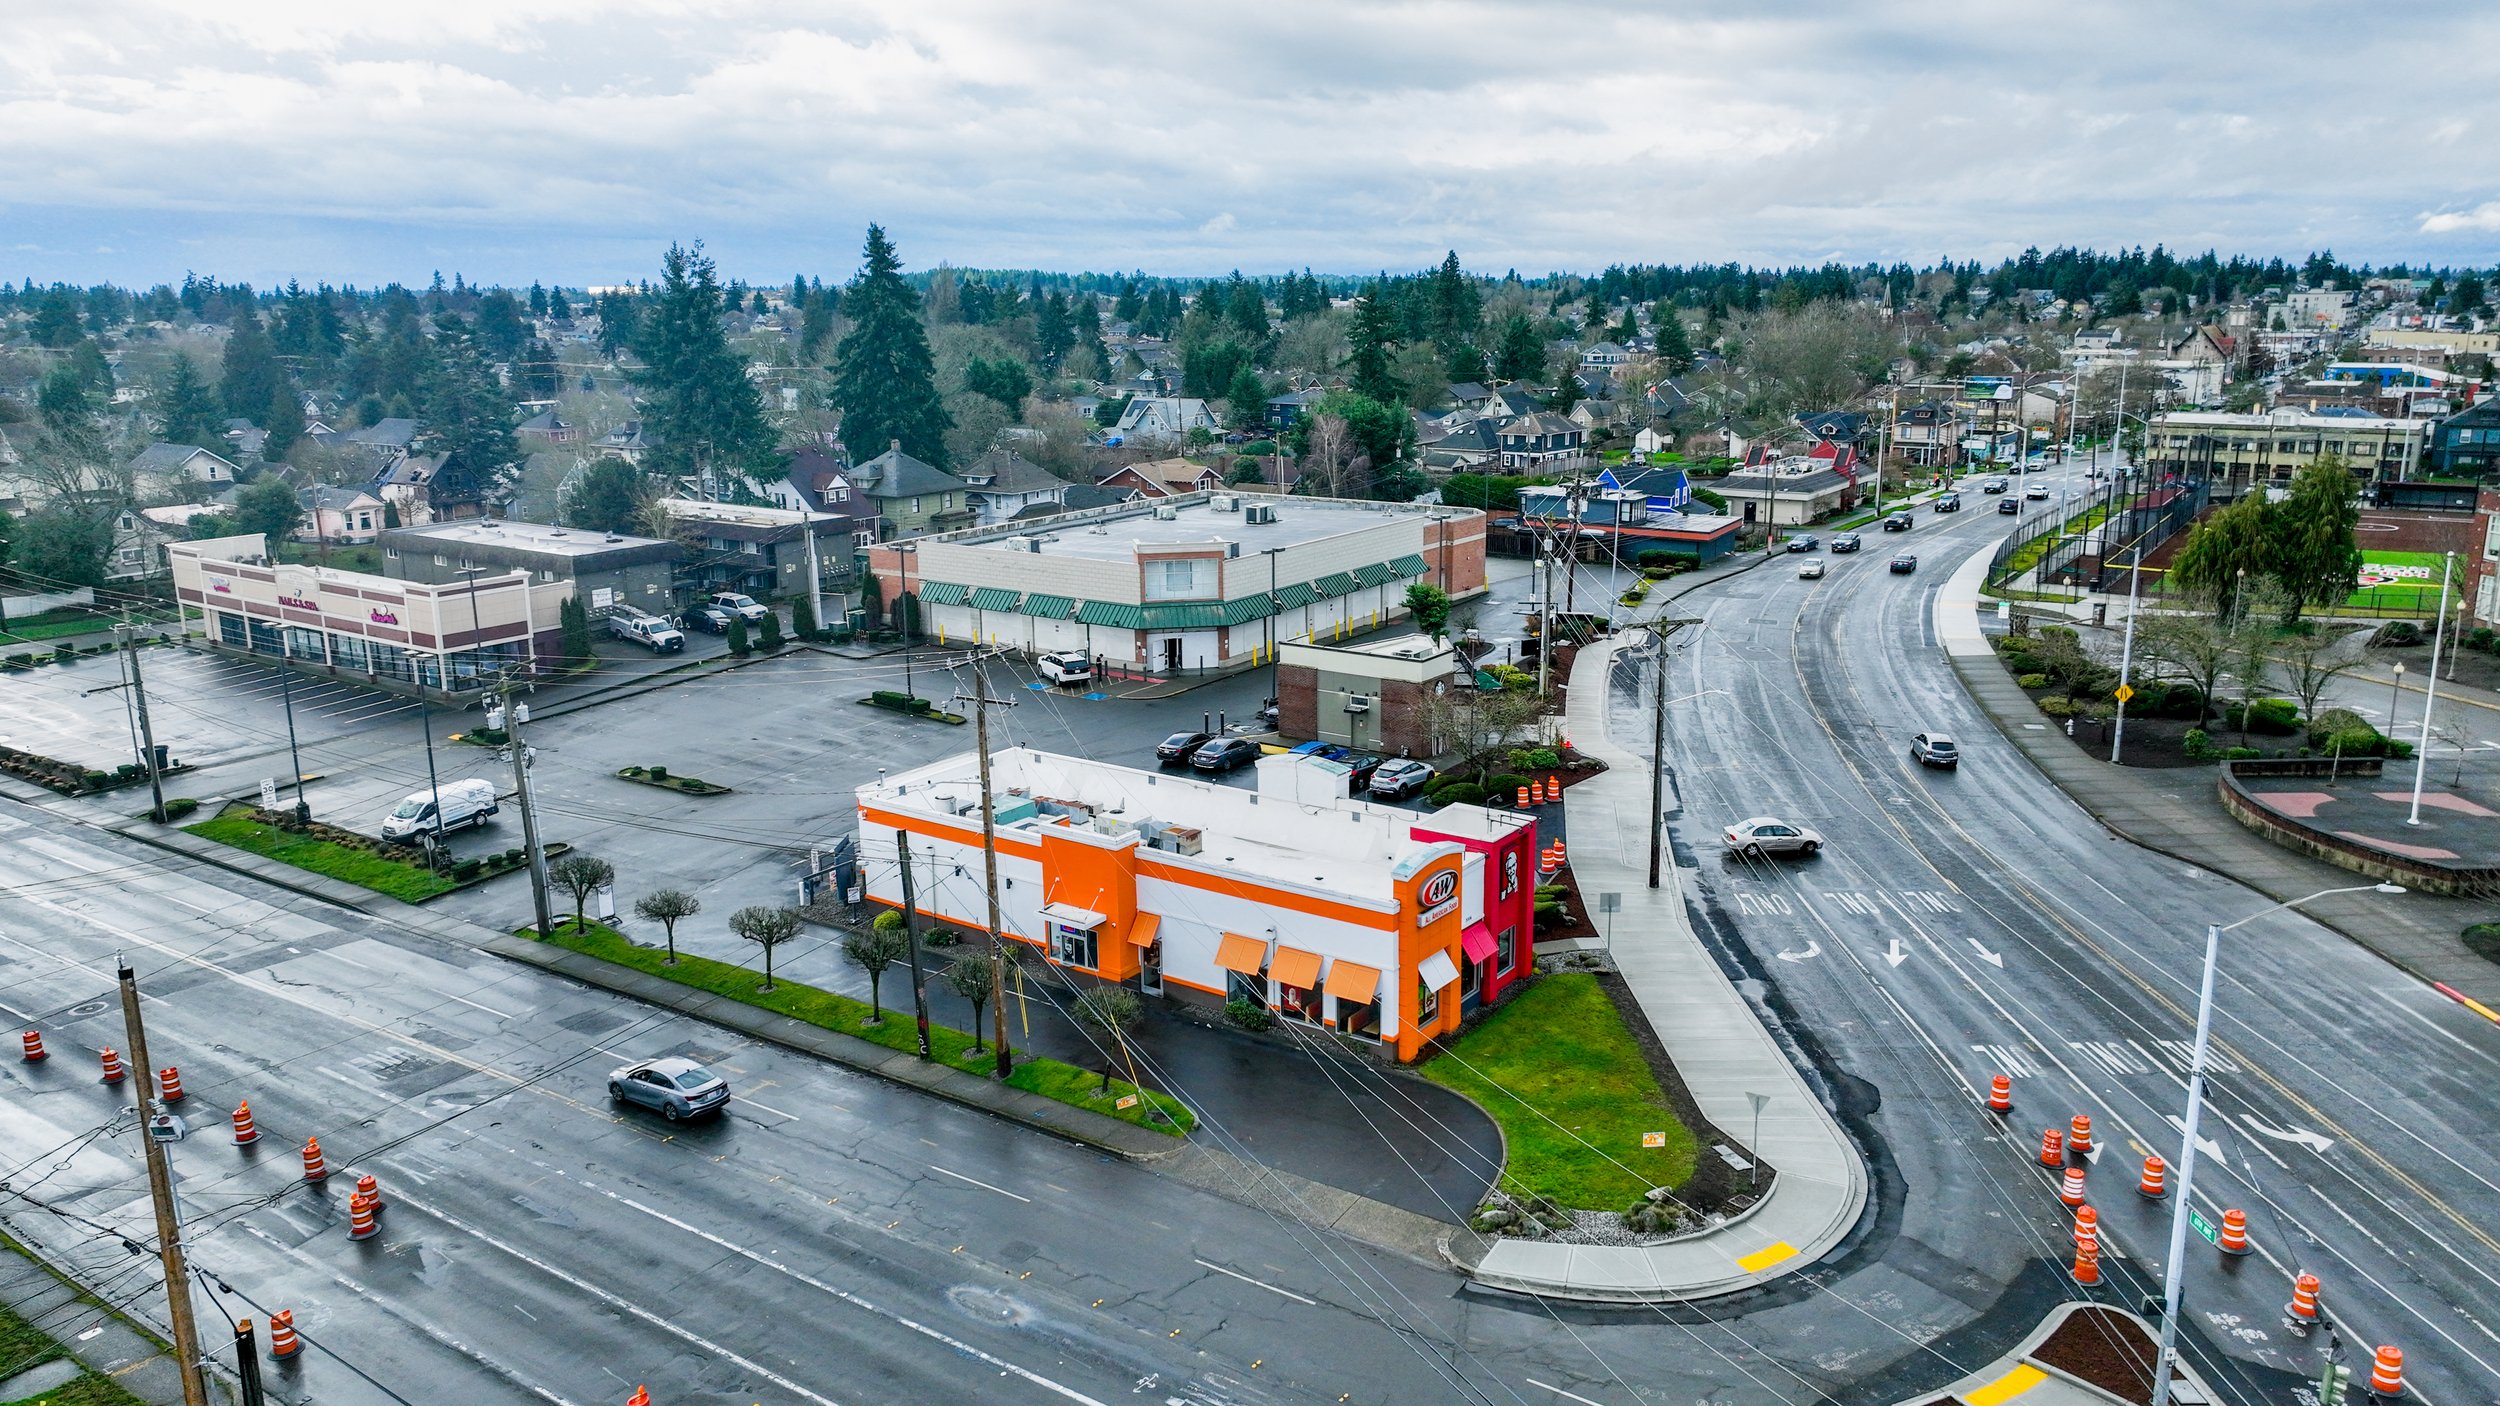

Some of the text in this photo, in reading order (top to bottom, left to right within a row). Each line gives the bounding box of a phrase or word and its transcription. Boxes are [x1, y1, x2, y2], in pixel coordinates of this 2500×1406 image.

[262, 785, 274, 794] 30
[2194, 1217, 2213, 1239] 6TH AVE
